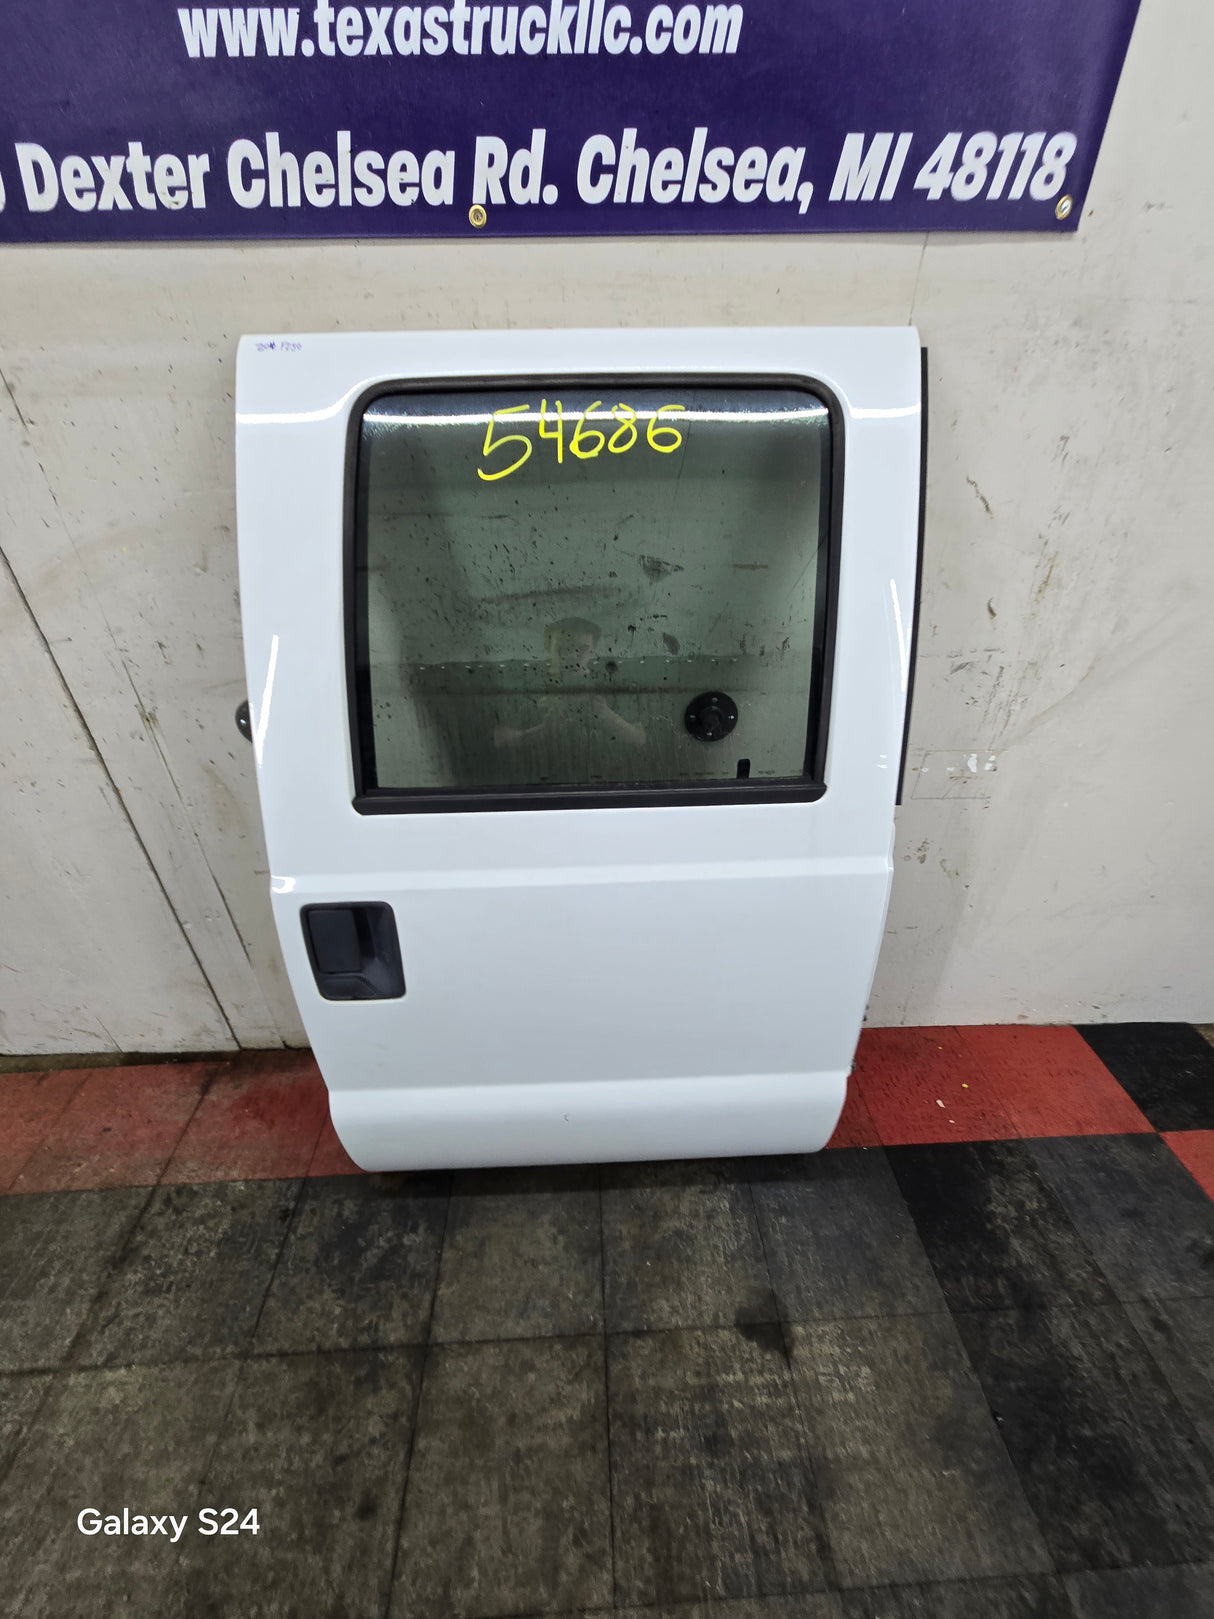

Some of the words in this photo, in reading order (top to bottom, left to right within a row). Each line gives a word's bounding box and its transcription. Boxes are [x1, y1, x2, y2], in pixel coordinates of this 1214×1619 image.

[177, 0, 744, 58] www.texastruckllc.com
[14, 141, 211, 212] Dexter
[227, 130, 456, 209] Chelsea
[472, 128, 559, 205] Rd.
[576, 127, 814, 215] Chelsea,
[828, 132, 914, 201] MI
[913, 131, 1078, 201] 48118
[477, 398, 686, 482] 54686
